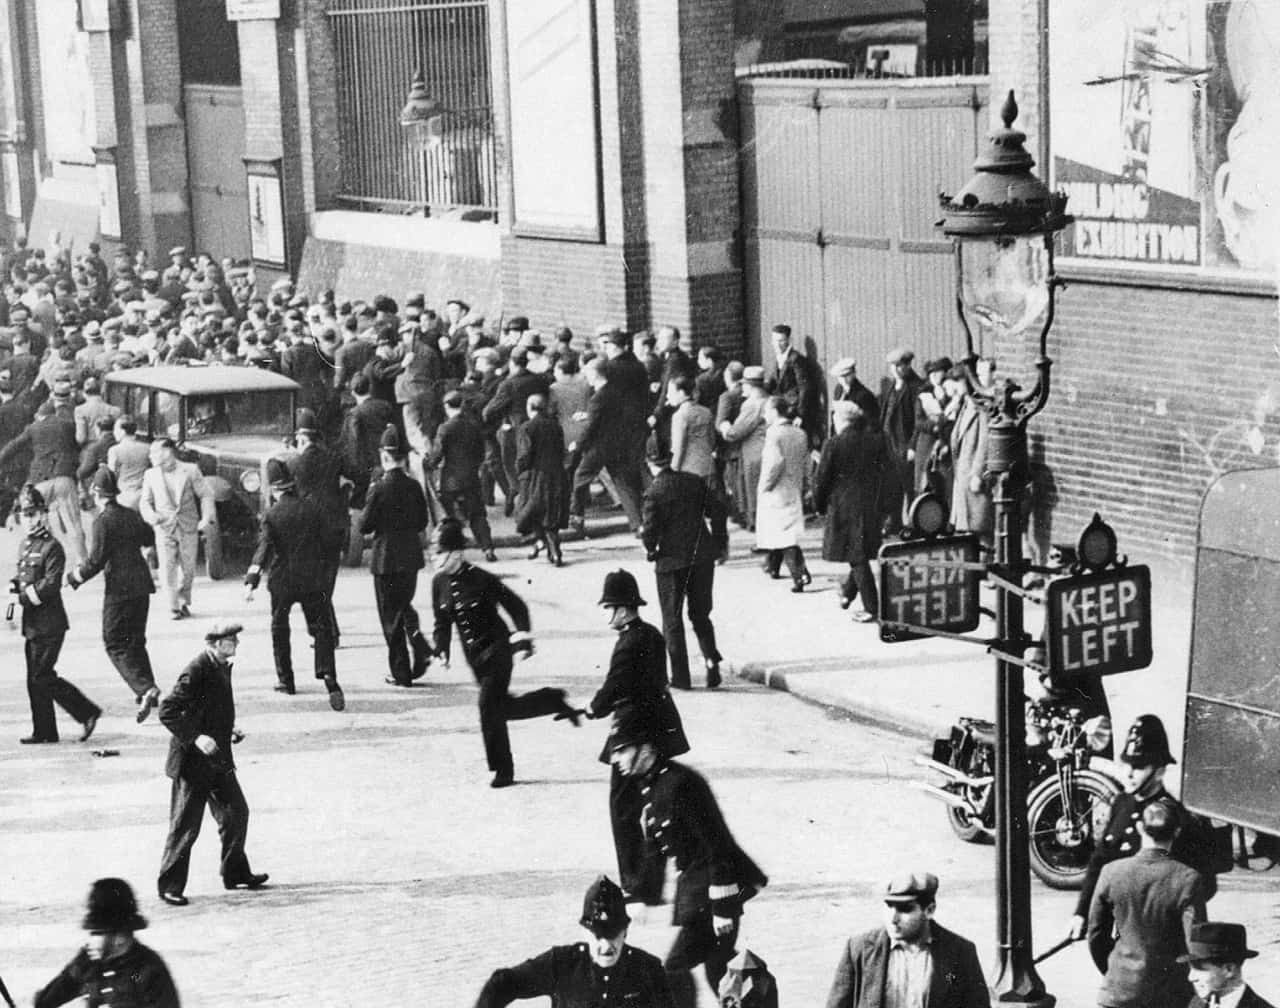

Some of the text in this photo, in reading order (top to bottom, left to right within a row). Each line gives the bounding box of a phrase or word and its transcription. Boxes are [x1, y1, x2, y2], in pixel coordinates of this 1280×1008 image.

[1076, 221, 1198, 261] EXHIBITION
[1060, 579, 1137, 629] KEEP
[1061, 620, 1140, 671] LEFT
